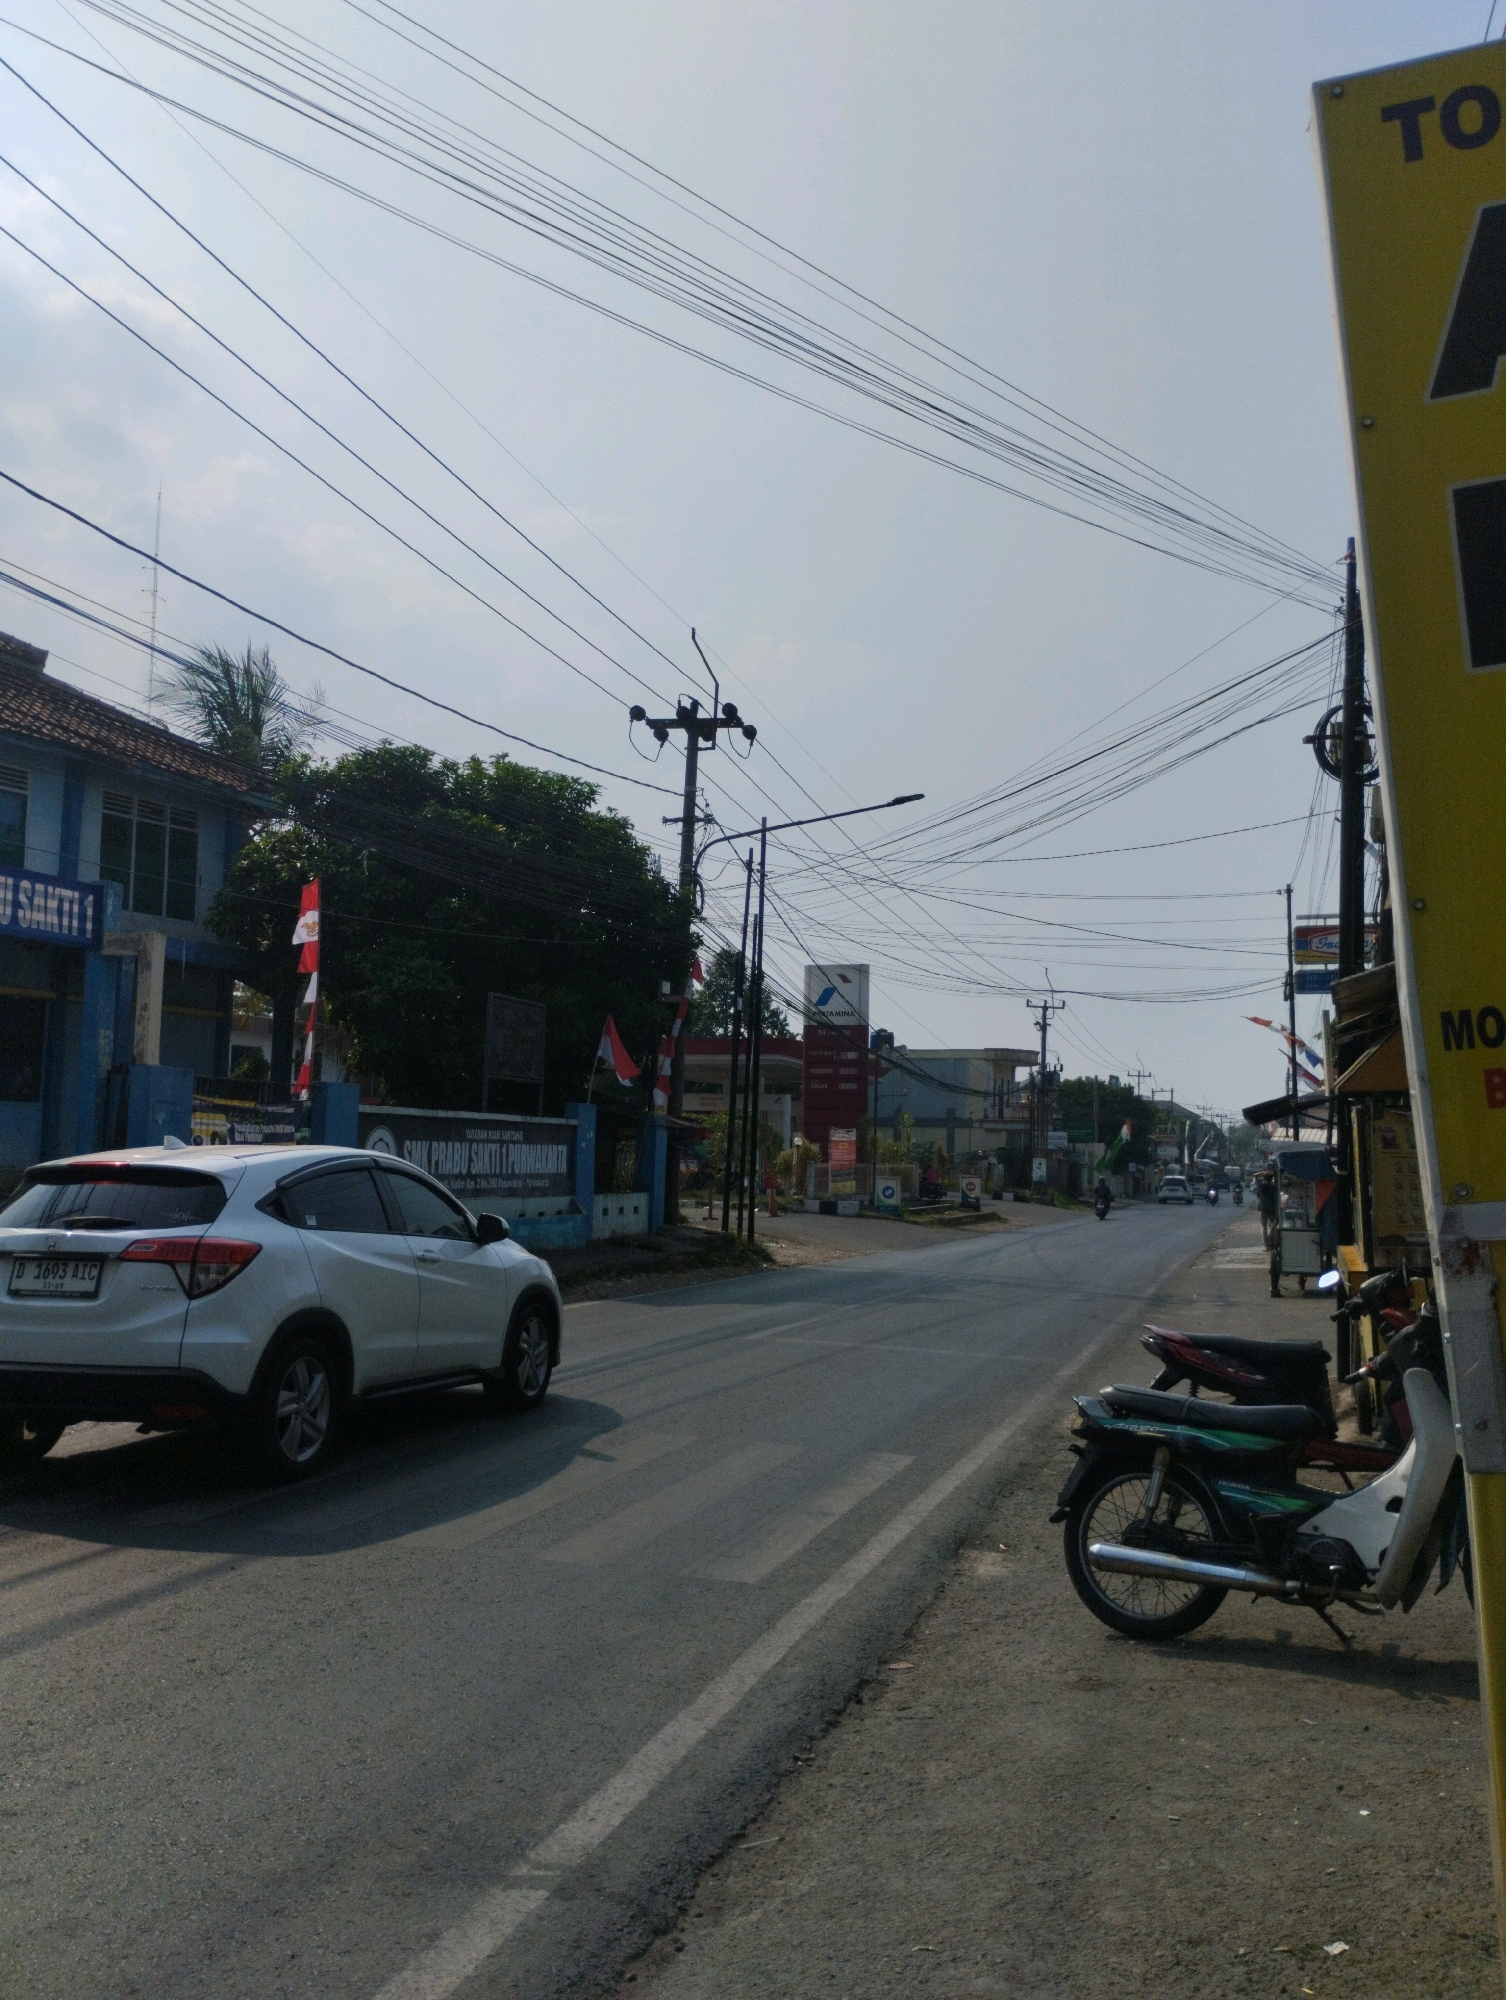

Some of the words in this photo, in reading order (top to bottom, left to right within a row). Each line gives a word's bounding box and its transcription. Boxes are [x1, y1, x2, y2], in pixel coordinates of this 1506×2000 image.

[1381, 85, 1501, 163] TO
[17, 880, 80, 936] SAKTI
[84, 894, 94, 939] 1
[1440, 1005, 1506, 1051] MO
[465, 1128, 488, 1139] YAYASAN
[404, 1140, 430, 1173] SMK
[431, 1141, 470, 1175] PRABU
[470, 1142, 500, 1175] SAKTI
[501, 1143, 507, 1174] 1
[508, 1144, 568, 1175] PURWAKARTA
[15, 1262, 26, 1279] D
[34, 1262, 68, 1280] 1693
[71, 1262, 97, 1280] AIC
[1218, 1480, 1251, 1491] HONDA
